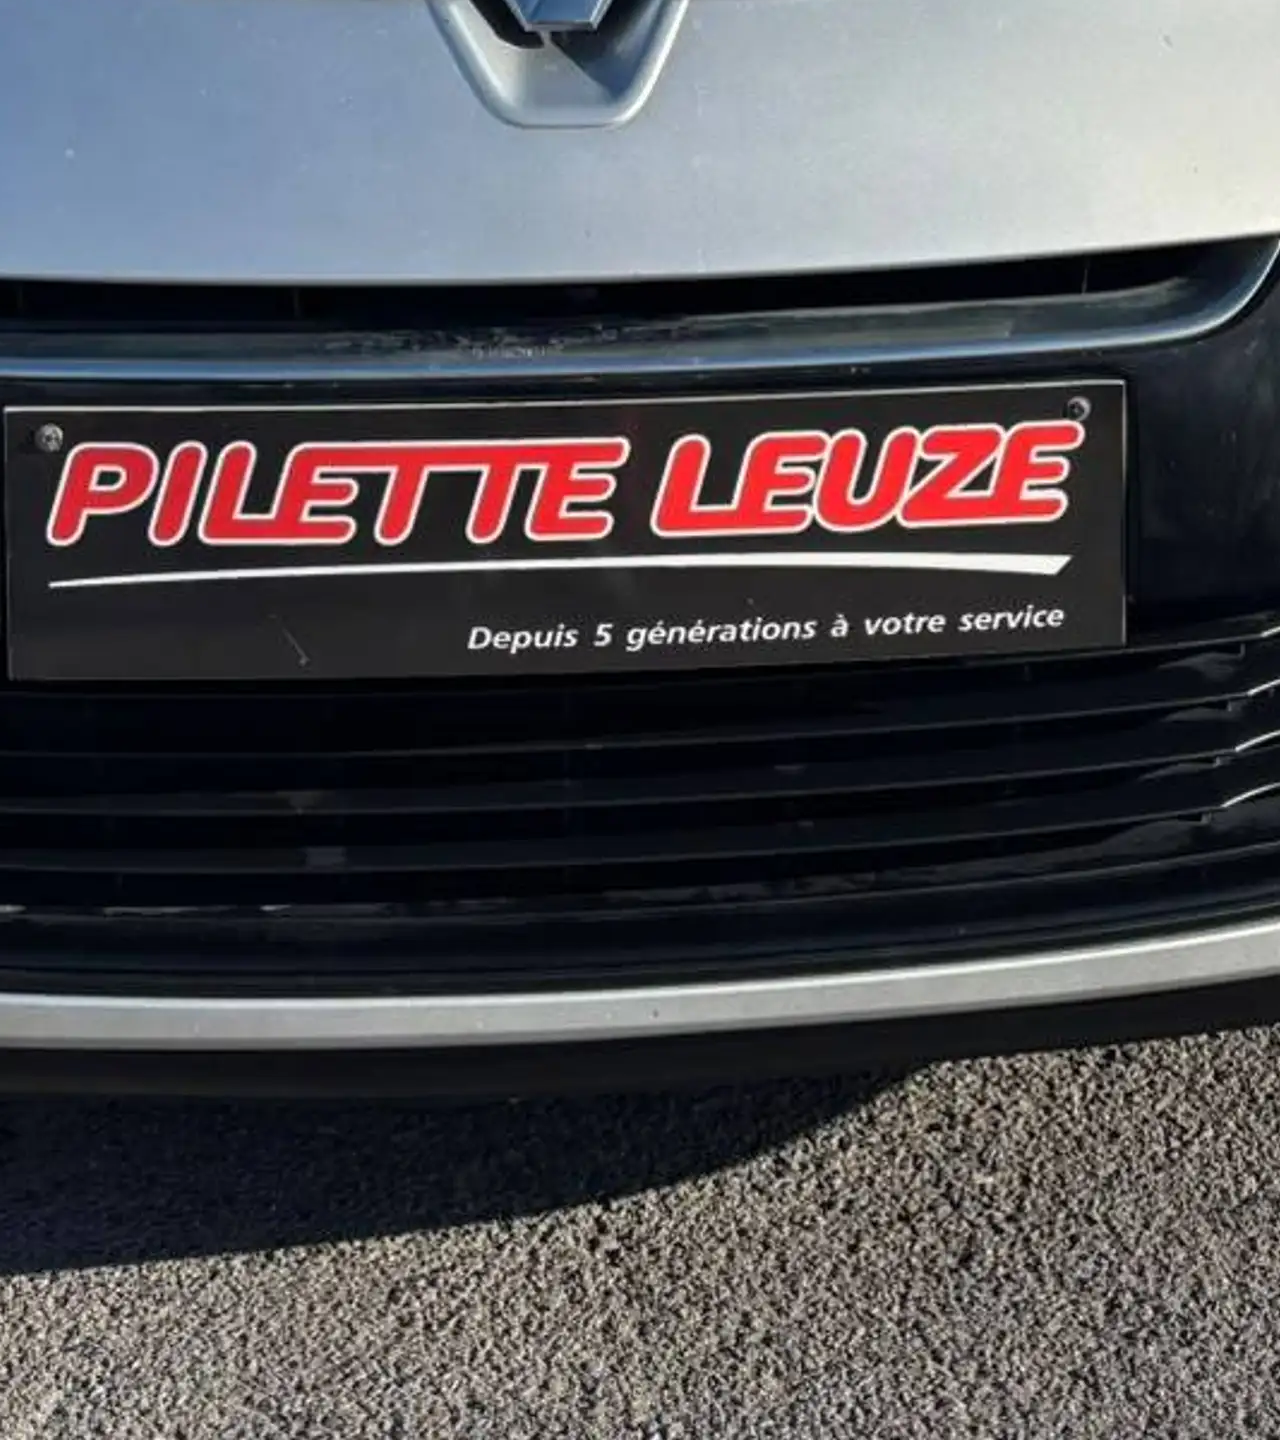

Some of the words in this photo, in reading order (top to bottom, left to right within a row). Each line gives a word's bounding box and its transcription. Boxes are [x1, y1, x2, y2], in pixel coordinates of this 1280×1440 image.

[46, 437, 630, 547] PILETTE
[651, 419, 1086, 538] LEUZE
[467, 623, 579, 655] Depuis
[593, 623, 613, 647] 5
[625, 615, 818, 652] générations
[830, 613, 849, 638] à
[864, 612, 946, 636] votre
[957, 604, 1065, 632] service
